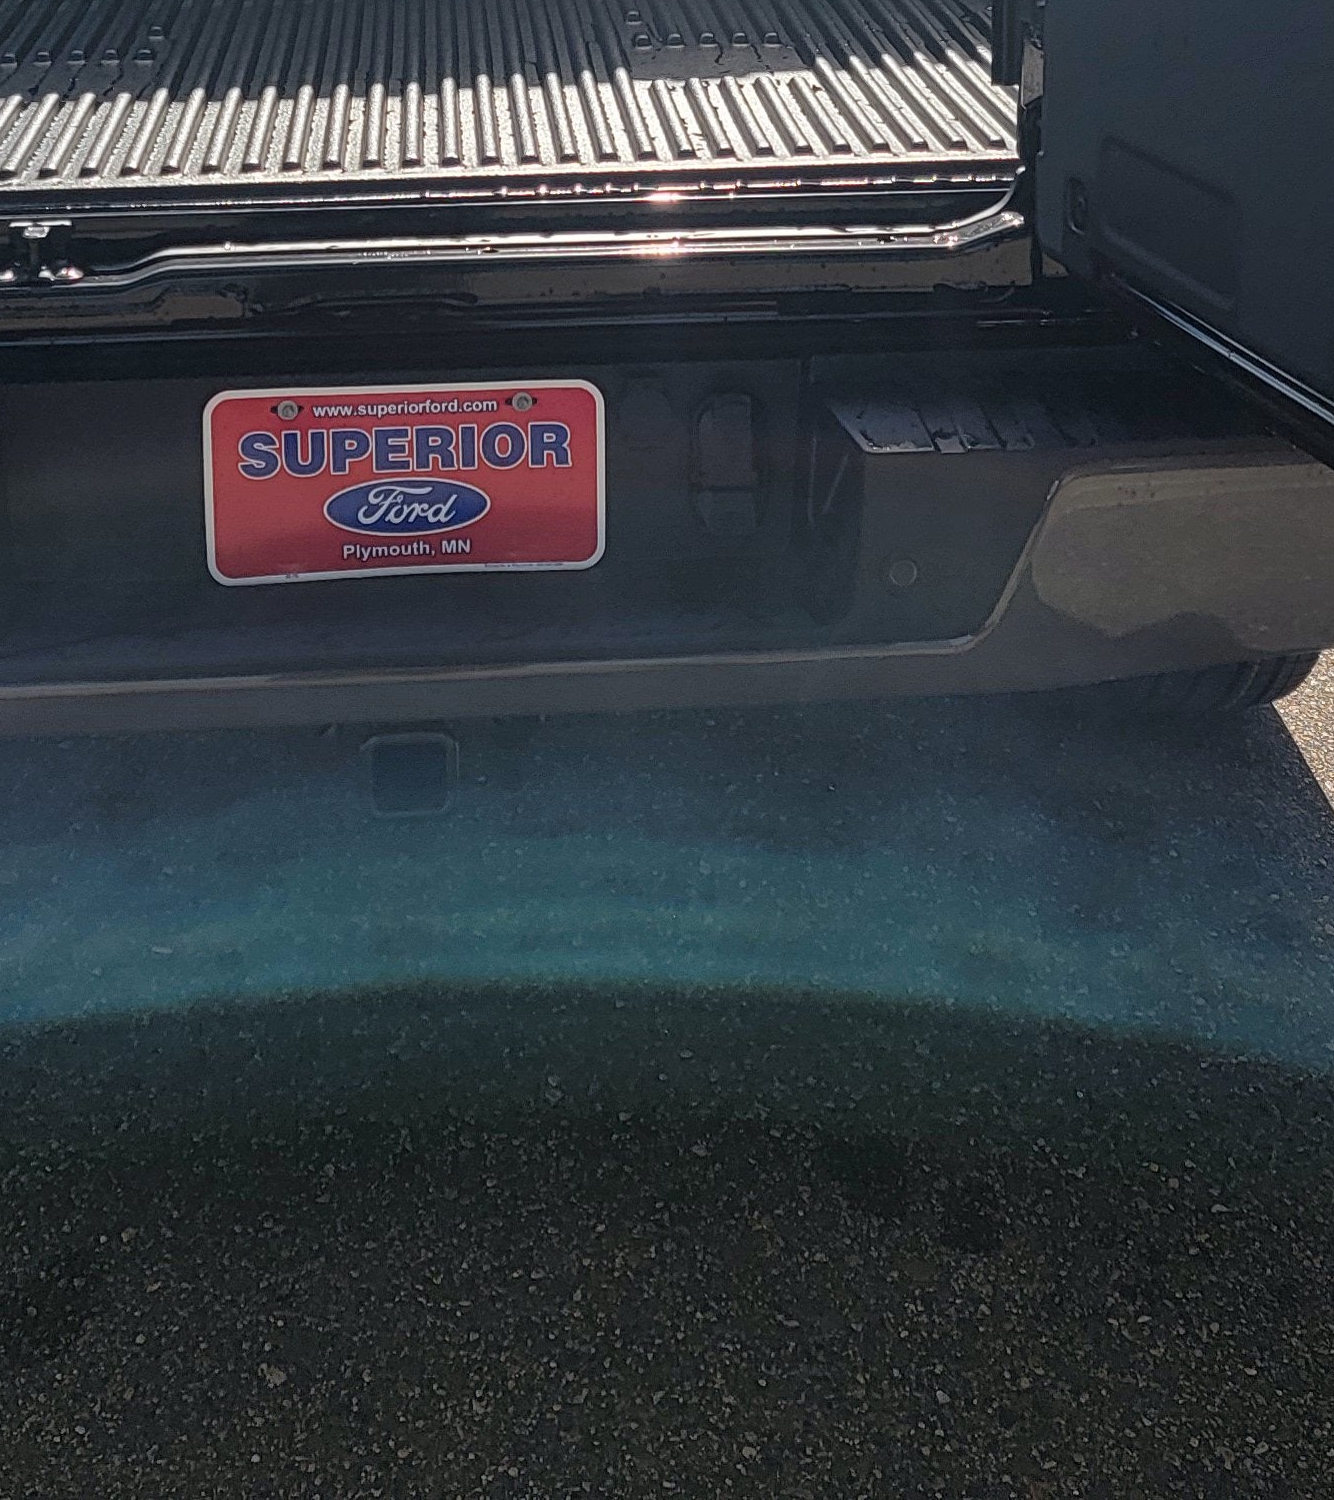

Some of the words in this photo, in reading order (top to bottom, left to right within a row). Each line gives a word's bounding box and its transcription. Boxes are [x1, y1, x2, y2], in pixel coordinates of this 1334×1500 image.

[312, 399, 498, 419] www.superiorford.com
[237, 420, 573, 481] SUPERIOR
[357, 485, 457, 525] Ford
[342, 541, 435, 560] Plymouth,
[441, 538, 471, 554] MN
